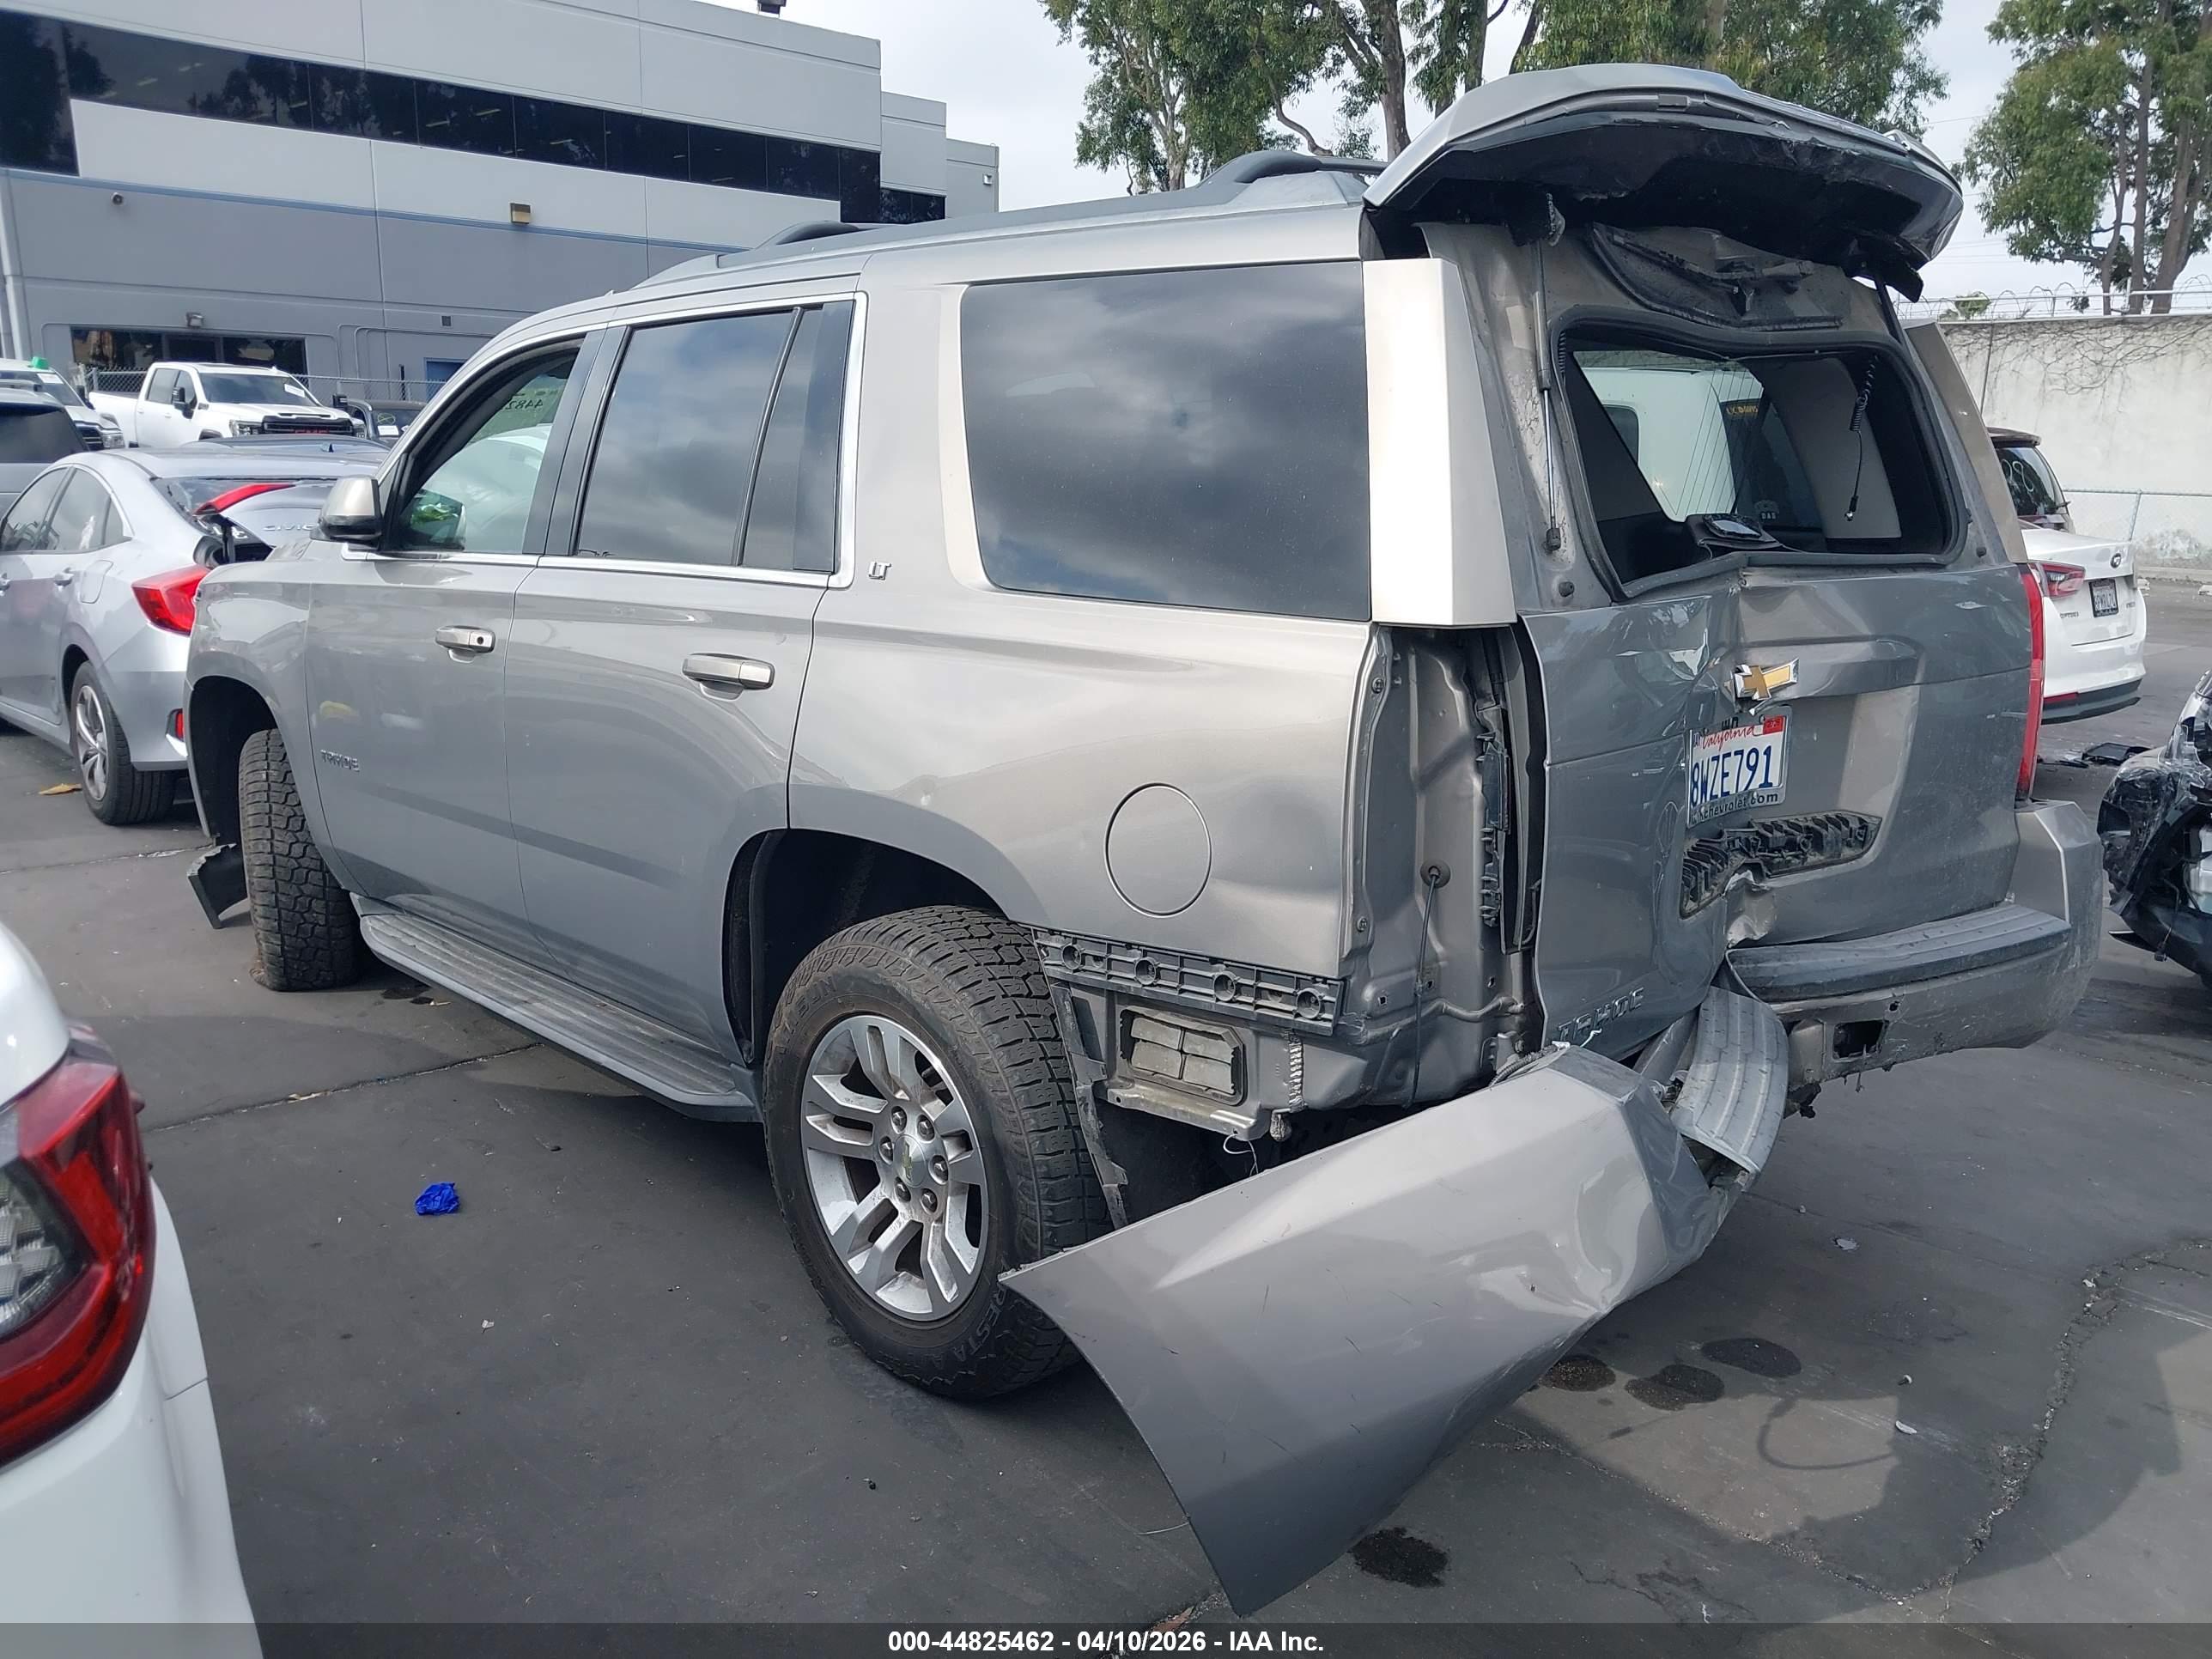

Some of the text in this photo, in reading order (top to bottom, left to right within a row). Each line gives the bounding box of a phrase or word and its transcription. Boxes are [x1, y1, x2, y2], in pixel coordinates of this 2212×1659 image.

[868, 561, 892, 580] LT
[1702, 726, 1760, 750] California
[320, 749, 360, 772] TAHOE
[1691, 745, 1773, 807] 8WZE791
[1559, 987, 1644, 1042] TAHOE
